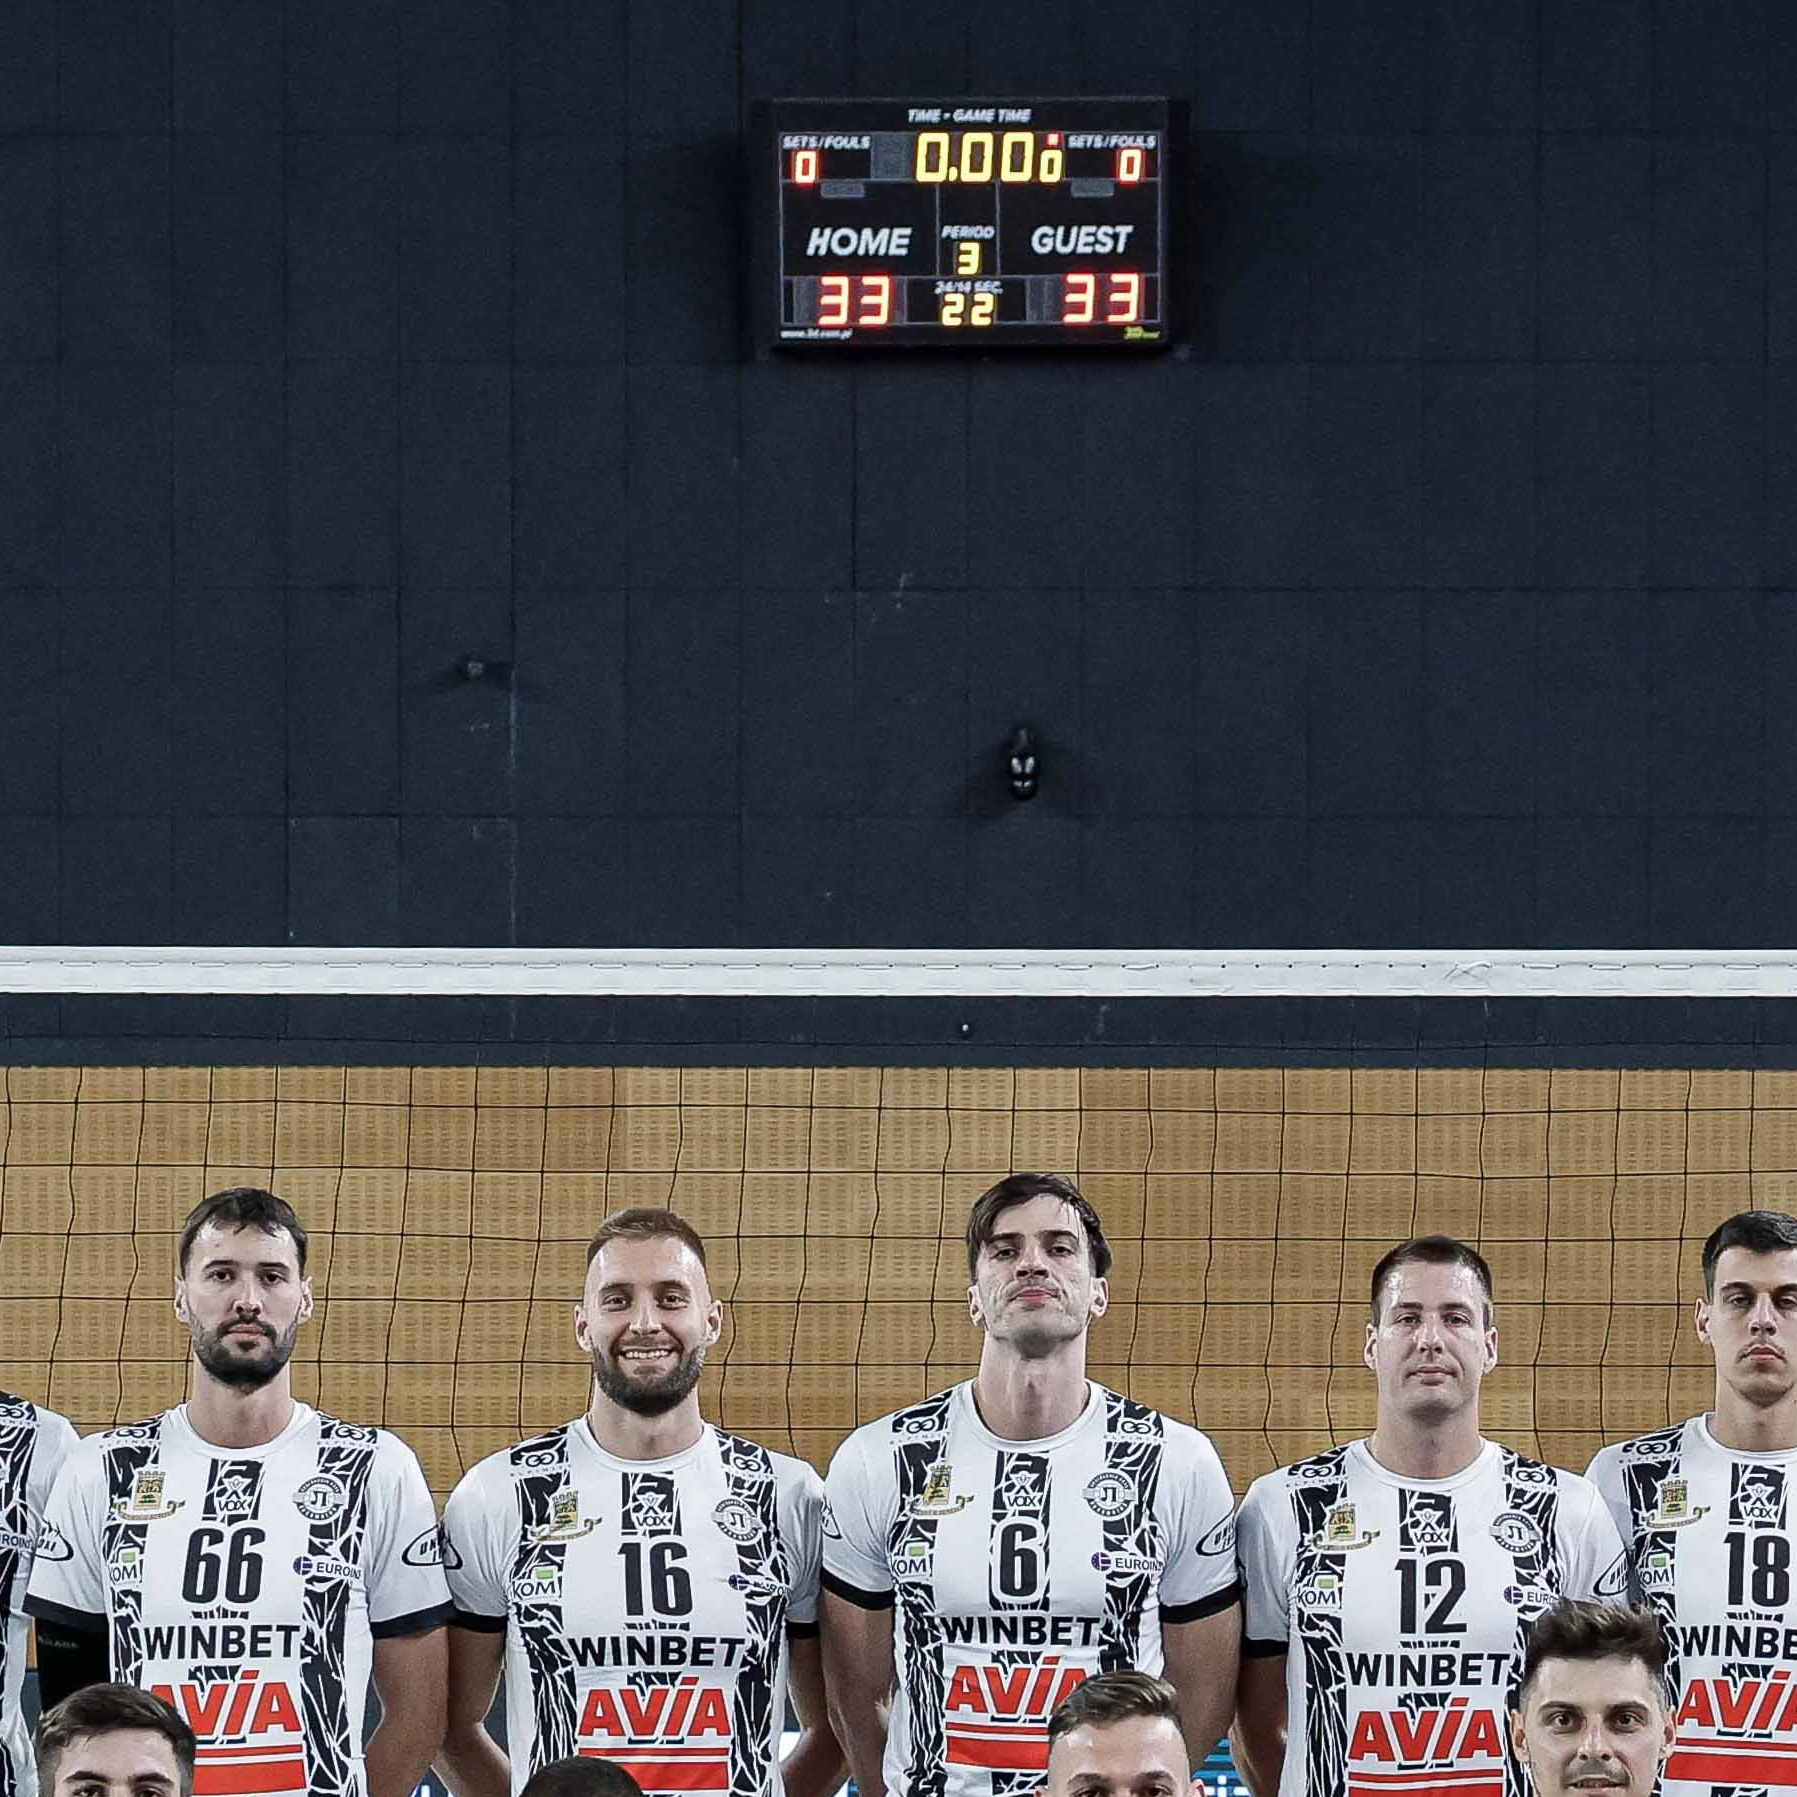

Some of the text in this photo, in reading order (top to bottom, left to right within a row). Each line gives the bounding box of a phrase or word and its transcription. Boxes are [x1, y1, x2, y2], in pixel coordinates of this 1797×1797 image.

[953, 109, 996, 123] GAME
[998, 109, 1032, 123] TIME
[795, 150, 817, 184] 0
[1119, 149, 1142, 182] 0
[806, 227, 913, 257] HOME
[941, 226, 995, 240] PERIOD
[1031, 226, 1133, 254] GUEST
[958, 242, 981, 275] 3
[818, 275, 893, 326] 33
[941, 292, 995, 326] 22
[1063, 273, 1141, 322] 33
[182, 1528, 266, 1604] 66
[1001, 1522, 1041, 1597] 6
[1723, 1532, 1791, 1606] 18
[617, 1542, 694, 1617] 16
[1394, 1559, 1468, 1634] 12
[144, 1624, 300, 1661] WINBET
[945, 1616, 1100, 1646] WINBET
[569, 1637, 747, 1668] WINBET
[1347, 1653, 1508, 1686] WINBET
